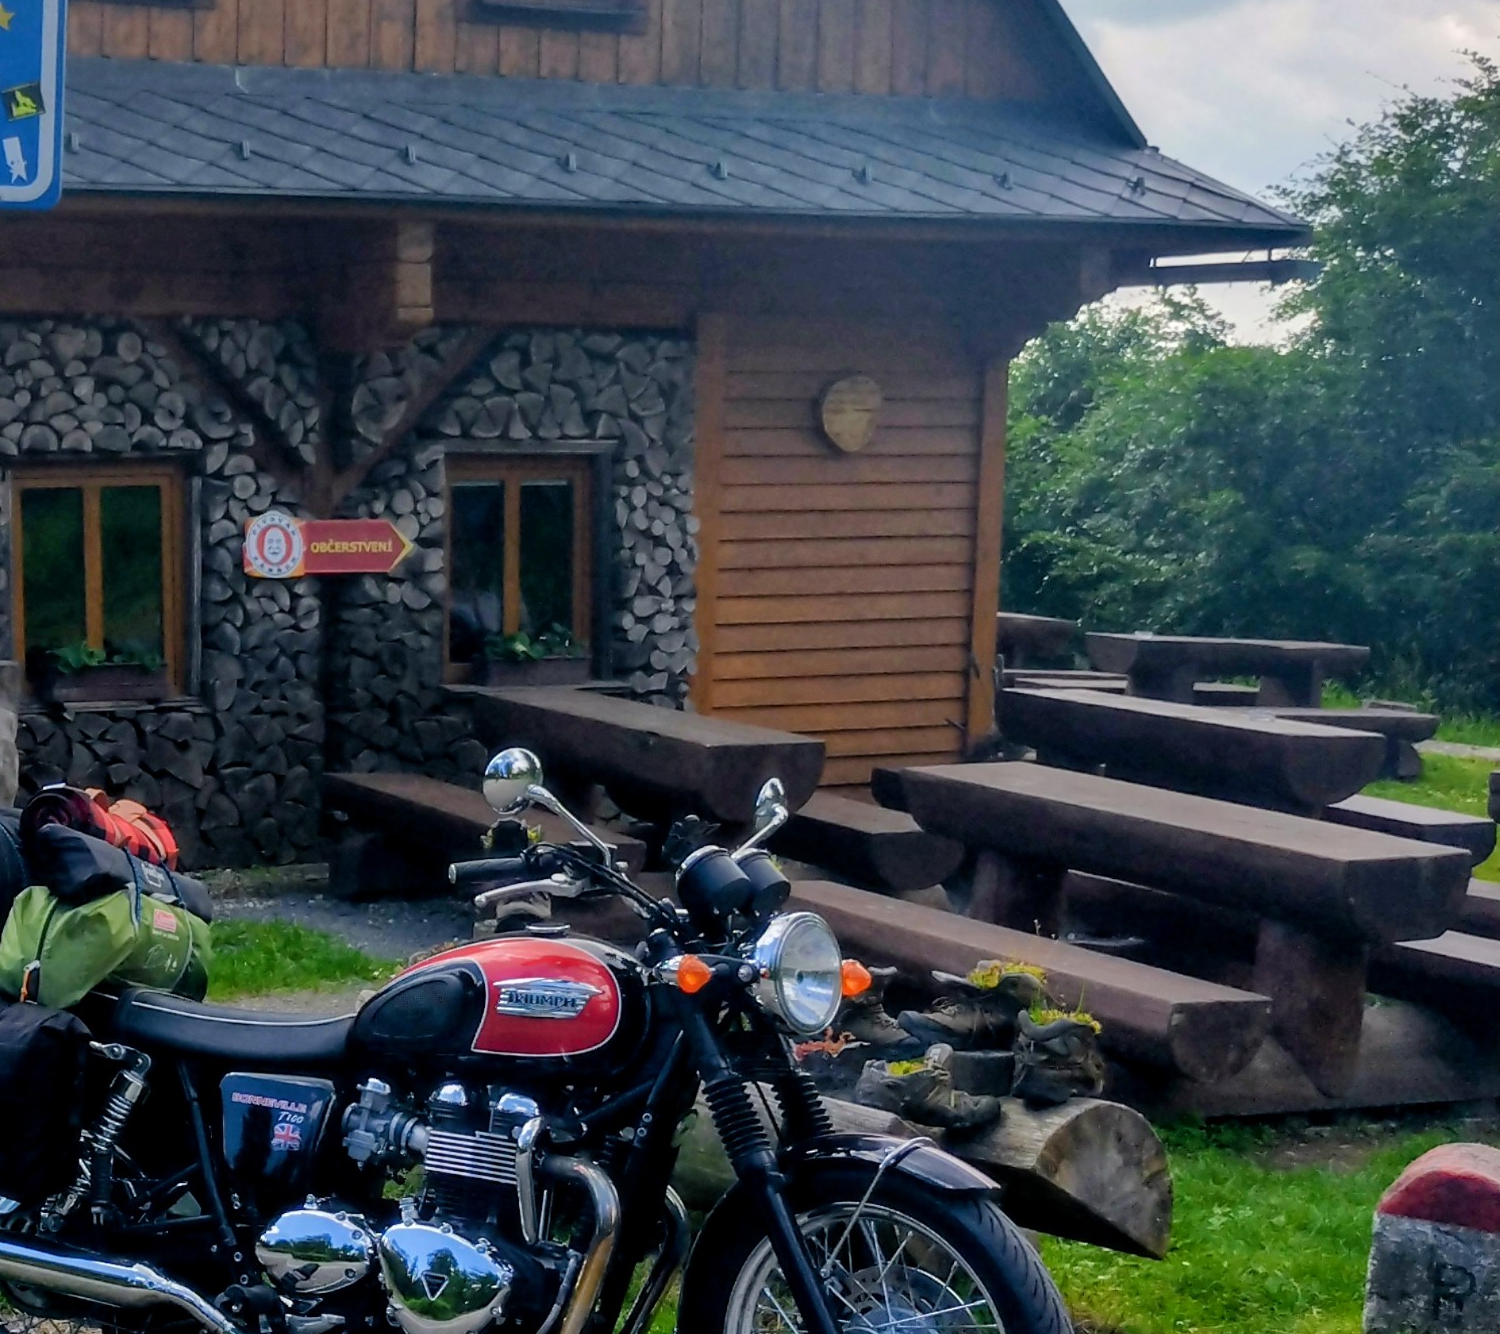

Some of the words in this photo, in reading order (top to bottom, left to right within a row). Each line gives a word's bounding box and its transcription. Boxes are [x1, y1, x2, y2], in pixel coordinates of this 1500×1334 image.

[310, 539, 392, 553] OBČERSTVENÍ
[508, 991, 577, 1008] TRIUMPH
[232, 1092, 307, 1113] BONNEVILLE
[278, 1111, 304, 1124] T100
